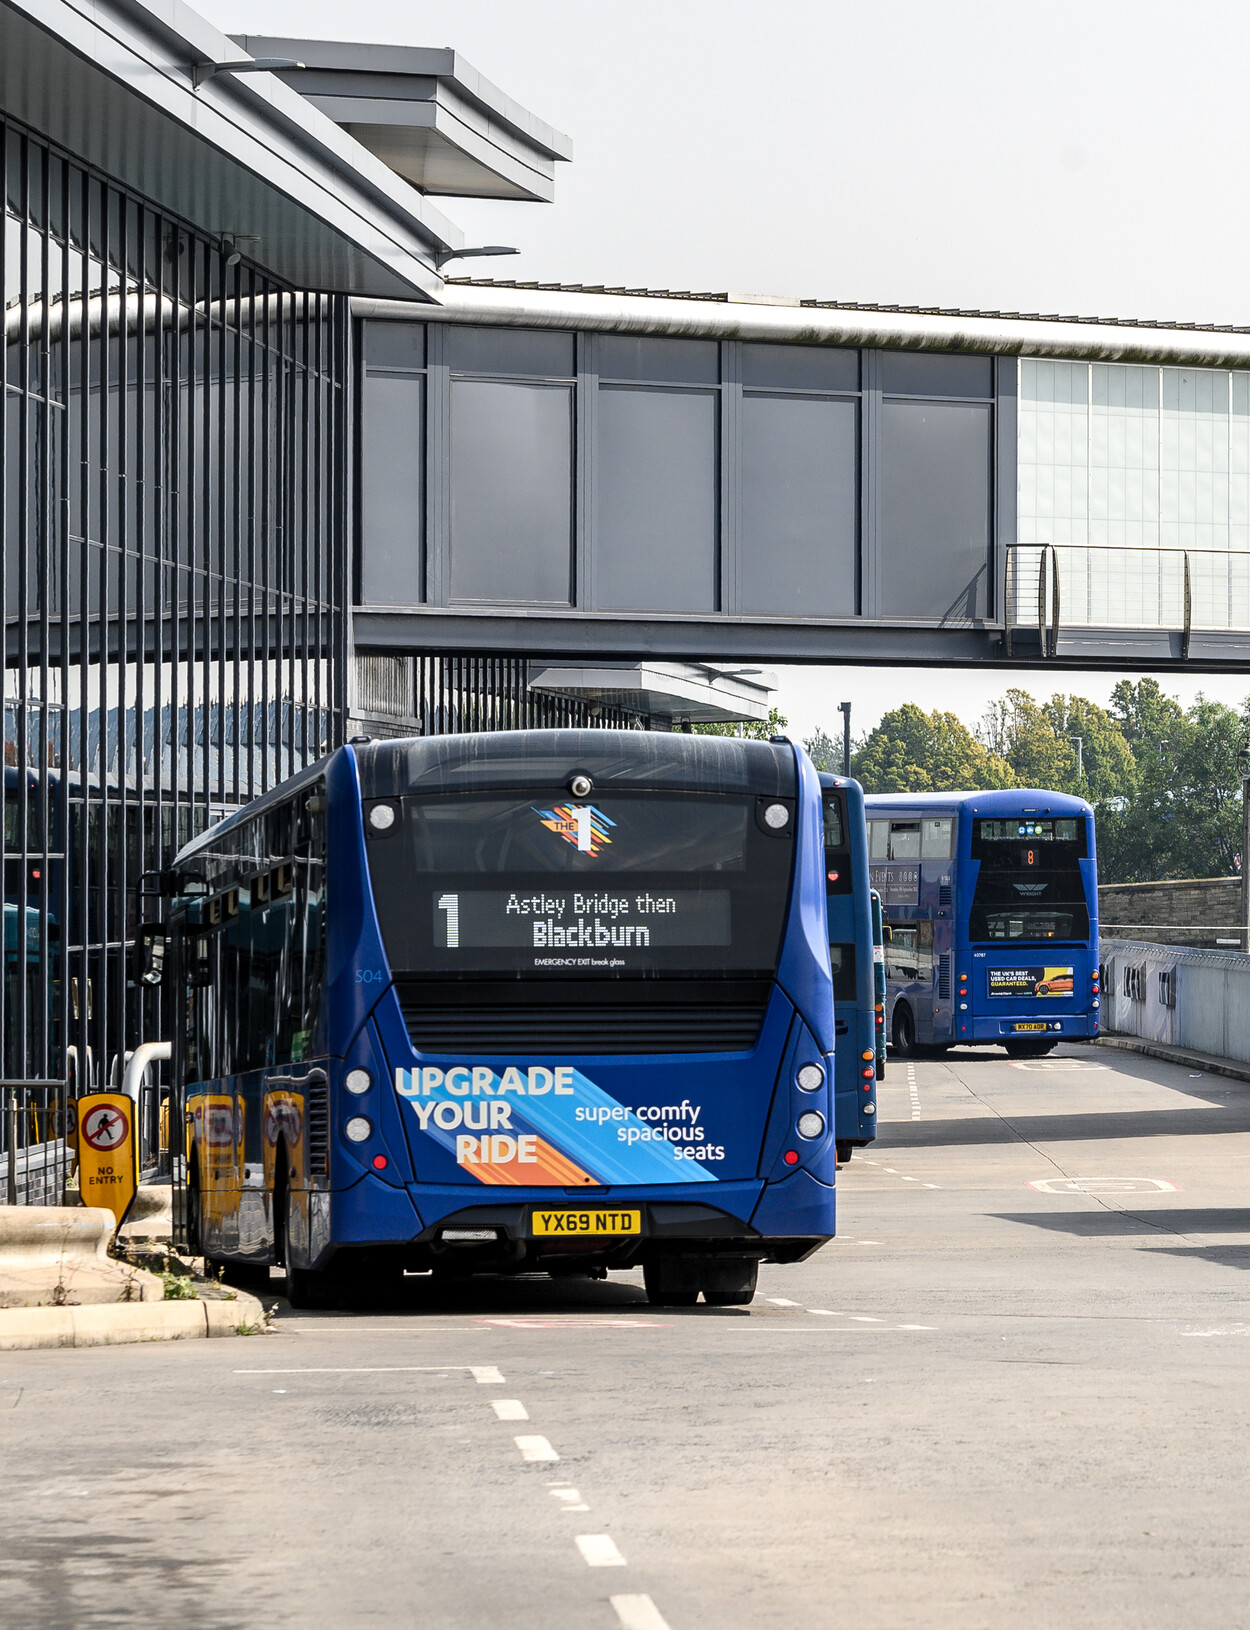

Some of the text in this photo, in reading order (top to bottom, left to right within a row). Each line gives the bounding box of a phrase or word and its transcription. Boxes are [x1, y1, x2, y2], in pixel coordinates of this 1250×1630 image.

[554, 821, 575, 831] THE
[571, 807, 592, 851] 1
[1027, 850, 1034, 865] 8
[506, 894, 676, 919] Astley Bridge then
[438, 894, 459, 948] 1
[533, 918, 650, 947] Blackburn
[534, 958, 625, 967] EMERGENCY EXIT break glass
[354, 969, 383, 984] 504
[394, 1066, 575, 1096] UPGRADE
[411, 1100, 513, 1130] YOUR
[575, 1099, 702, 1125] super comfy
[617, 1122, 705, 1146] spacious
[456, 1134, 538, 1164] RIDE
[673, 1144, 725, 1161] seats
[88, 1175, 124, 1185] ENTRY
[97, 1166, 114, 1175] NO
[541, 1213, 632, 1232] YX69 NTD
